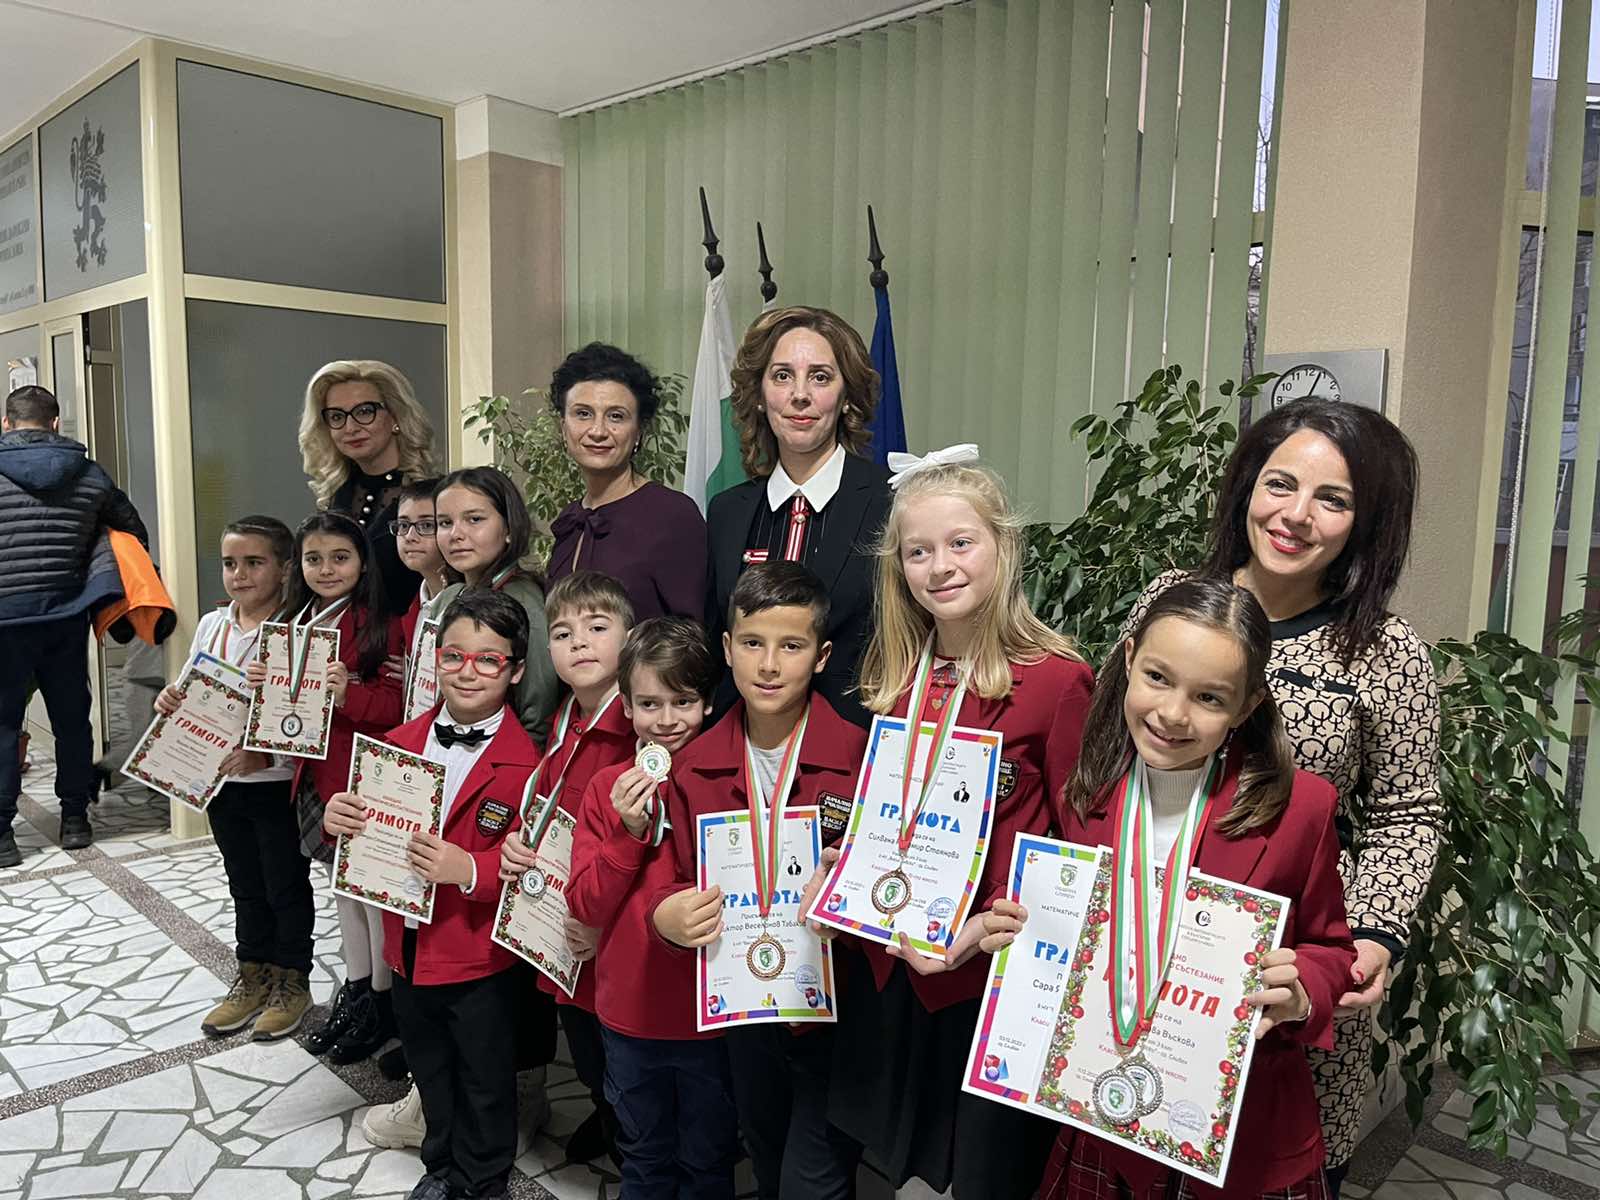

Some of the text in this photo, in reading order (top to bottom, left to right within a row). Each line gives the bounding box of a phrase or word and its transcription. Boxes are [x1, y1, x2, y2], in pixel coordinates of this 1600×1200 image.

[1291, 372, 1301, 381] 11
[1304, 368, 1315, 376] 12
[1321, 371, 1326, 379] 1
[1281, 382, 1292, 391] 10
[1329, 381, 1337, 390] 2
[1276, 396, 1283, 405] 9
[270, 675, 321, 690] ГРАОТА
[175, 717, 228, 749] ГРАМОТА
[367, 808, 421, 832] РАМОТА
[880, 803, 960, 833] ГРМОТА
[1175, 963, 1225, 985] СЪСТЕЗАНИЕ
[1032, 979, 1054, 993] Сара
[1162, 1030, 1195, 1048] Въскова
